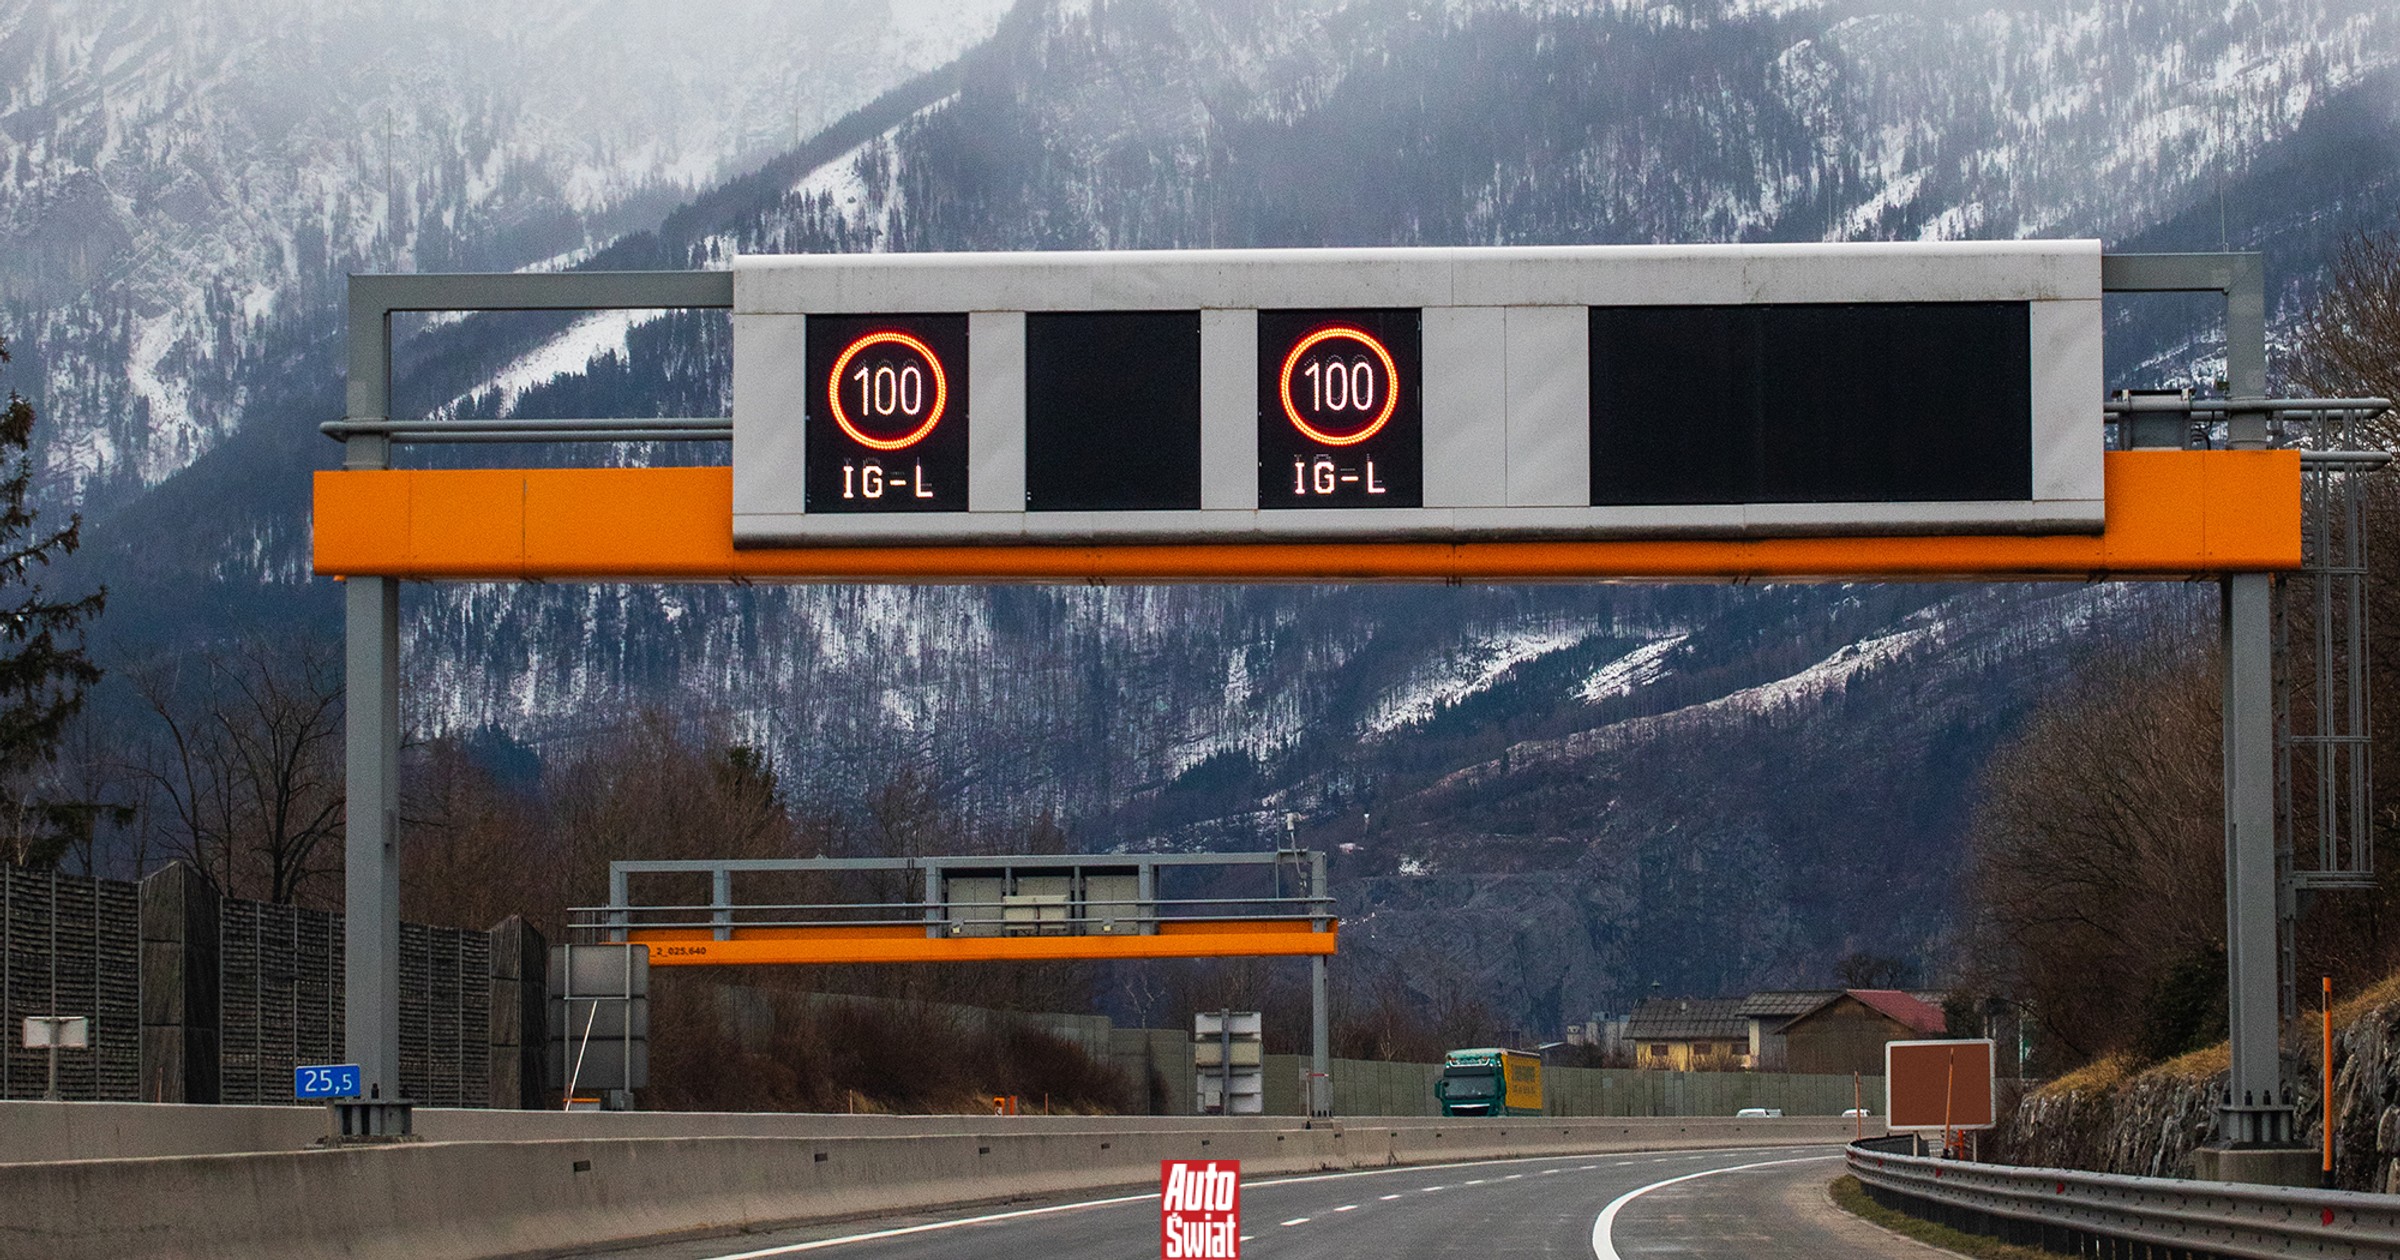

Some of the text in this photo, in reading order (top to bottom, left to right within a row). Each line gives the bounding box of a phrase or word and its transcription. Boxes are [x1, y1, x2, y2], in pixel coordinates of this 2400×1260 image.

[854, 366, 922, 416] 100
[1305, 361, 1374, 411] 100
[843, 465, 934, 498] IG-L
[1294, 461, 1386, 494] IG-L
[304, 1069, 353, 1095] 25,5
